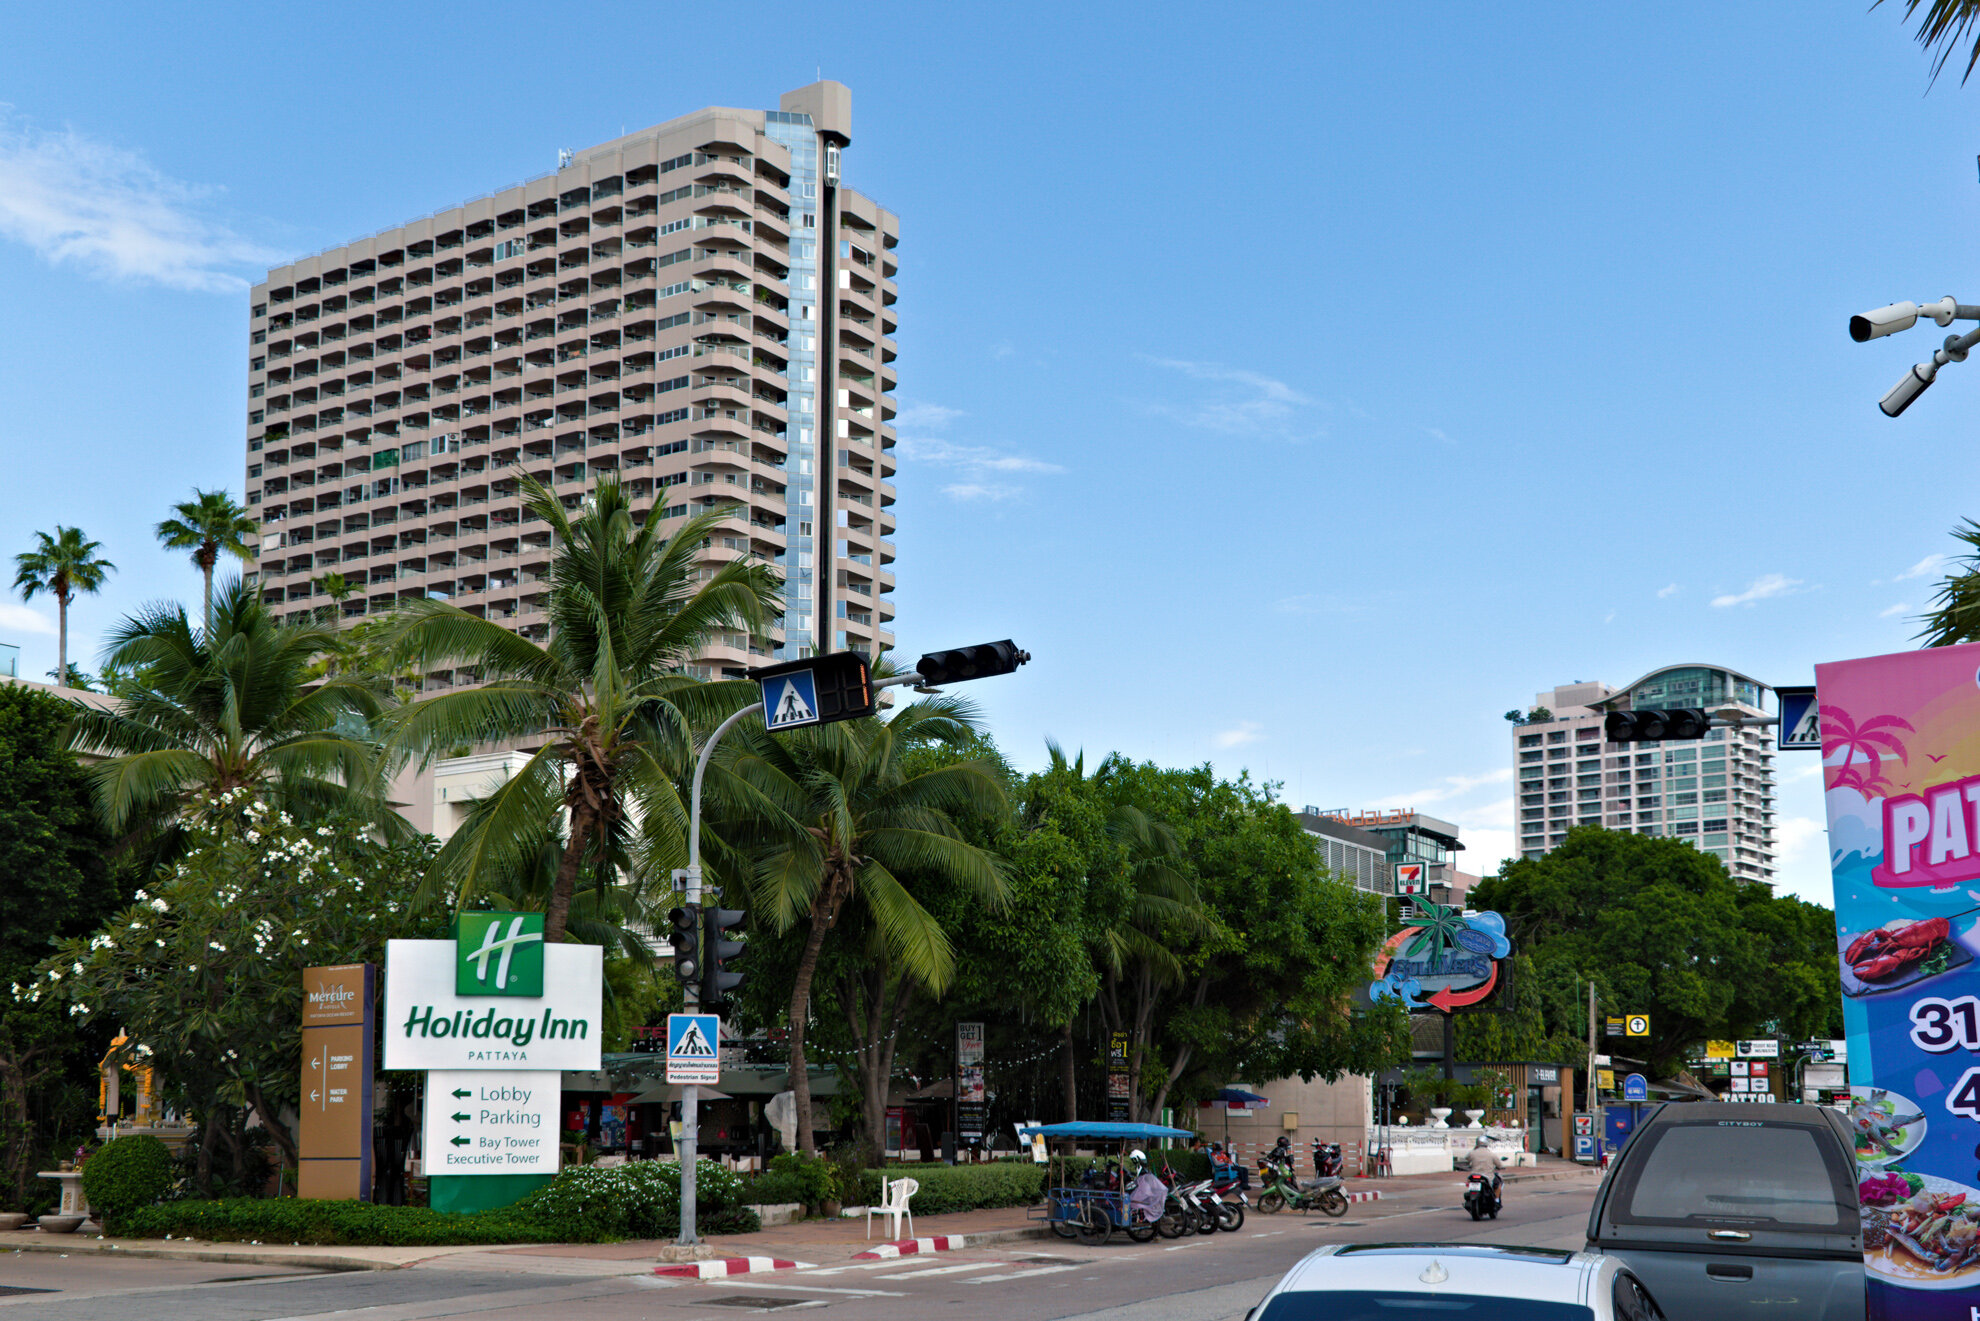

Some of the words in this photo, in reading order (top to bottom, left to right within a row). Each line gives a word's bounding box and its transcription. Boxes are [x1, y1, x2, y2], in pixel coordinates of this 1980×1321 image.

[308, 991, 355, 1003] Mercure
[404, 1005, 536, 1047] Holiday
[540, 1008, 588, 1040] Inn
[960, 1024, 976, 1032] BUY
[468, 1051, 527, 1061] PATTAYA
[481, 1086, 532, 1105] Lobby
[1721, 1093, 1776, 1104] TATTOO
[480, 1109, 541, 1128] Parking
[479, 1136, 501, 1151] Bay
[504, 1136, 541, 1148] Tower
[1577, 1138, 1592, 1153] P
[446, 1153, 503, 1165] Executive
[505, 1153, 540, 1164] Tower
